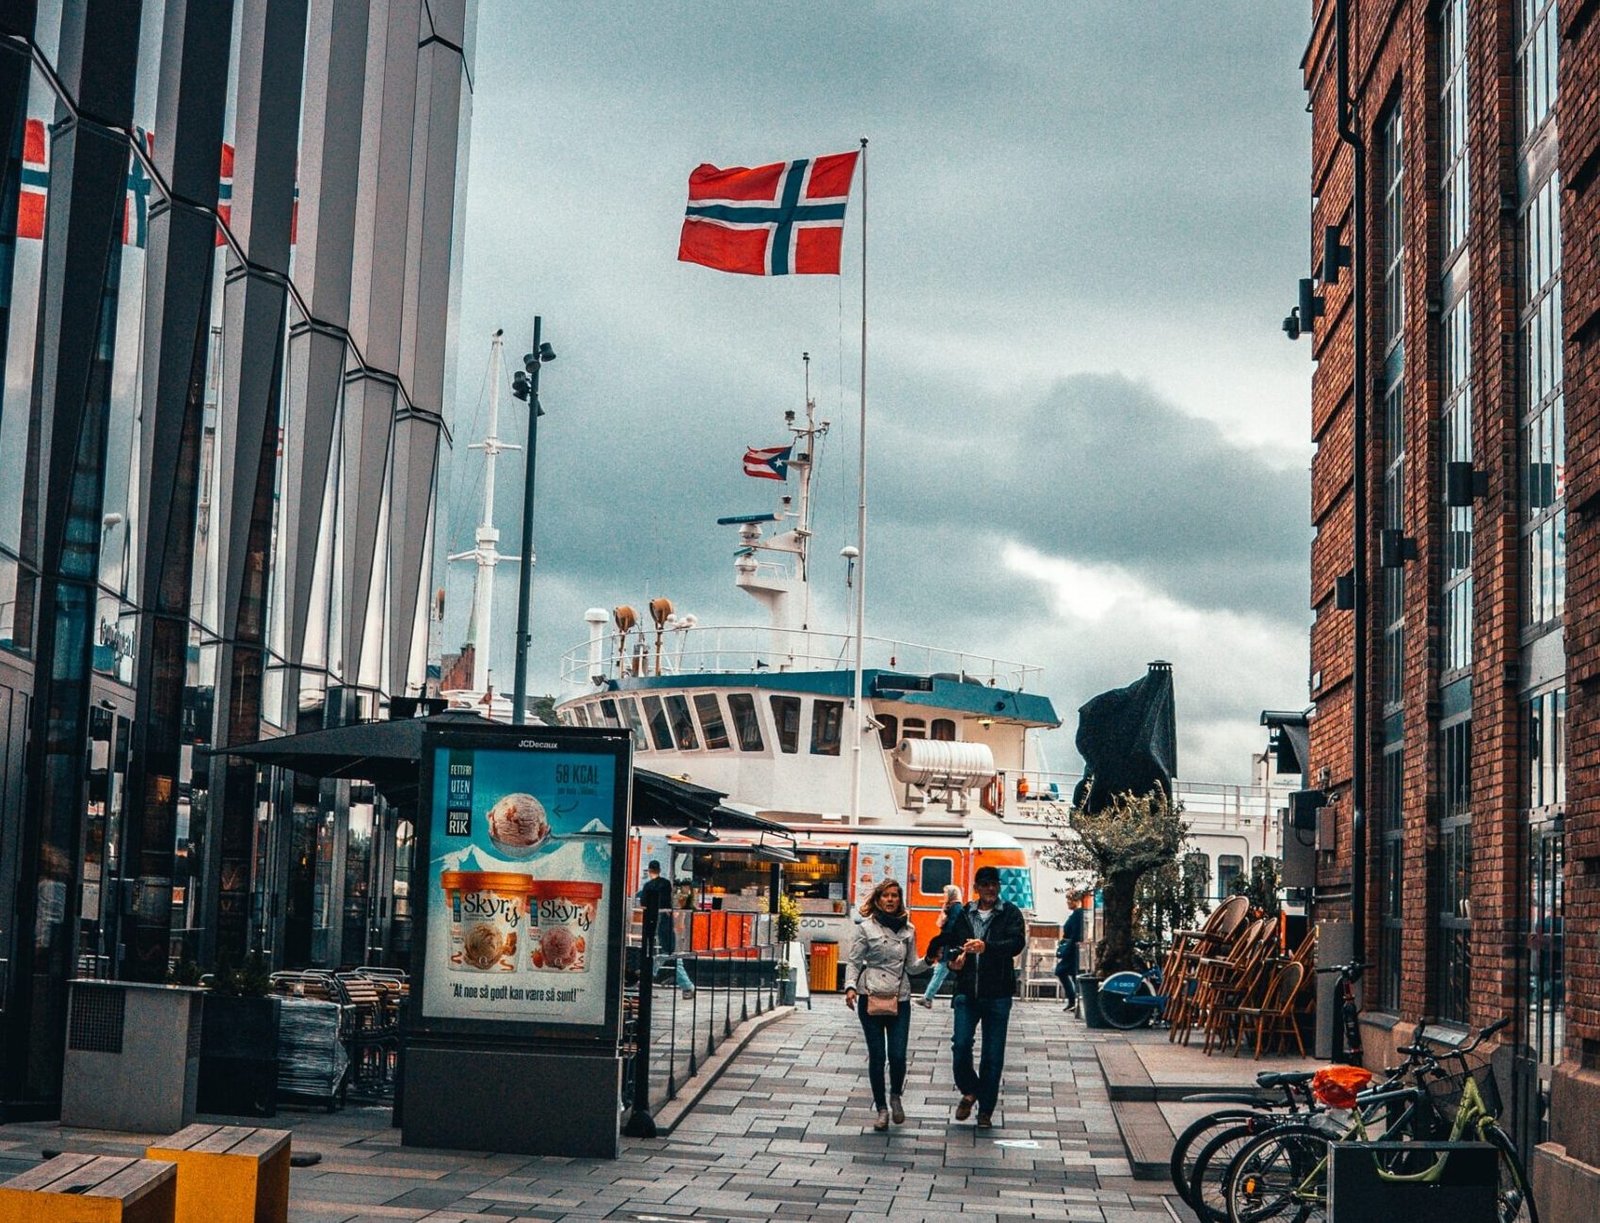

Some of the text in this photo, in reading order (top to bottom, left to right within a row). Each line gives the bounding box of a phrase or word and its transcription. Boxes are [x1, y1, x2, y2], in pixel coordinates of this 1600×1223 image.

[518, 740, 558, 749] JCDecaux
[556, 763, 600, 785] 58 KCAL
[451, 780, 471, 794] UTEN
[448, 820, 468, 834] RIK
[464, 893, 509, 917] Skyr
[540, 900, 582, 922] Skyr
[801, 919, 825, 928] OOD
[464, 986, 478, 998] noe
[480, 984, 489, 999] så
[490, 985, 507, 1001] godt
[509, 985, 524, 1000] kan
[525, 988, 545, 1001] være
[546, 987, 555, 1002] så
